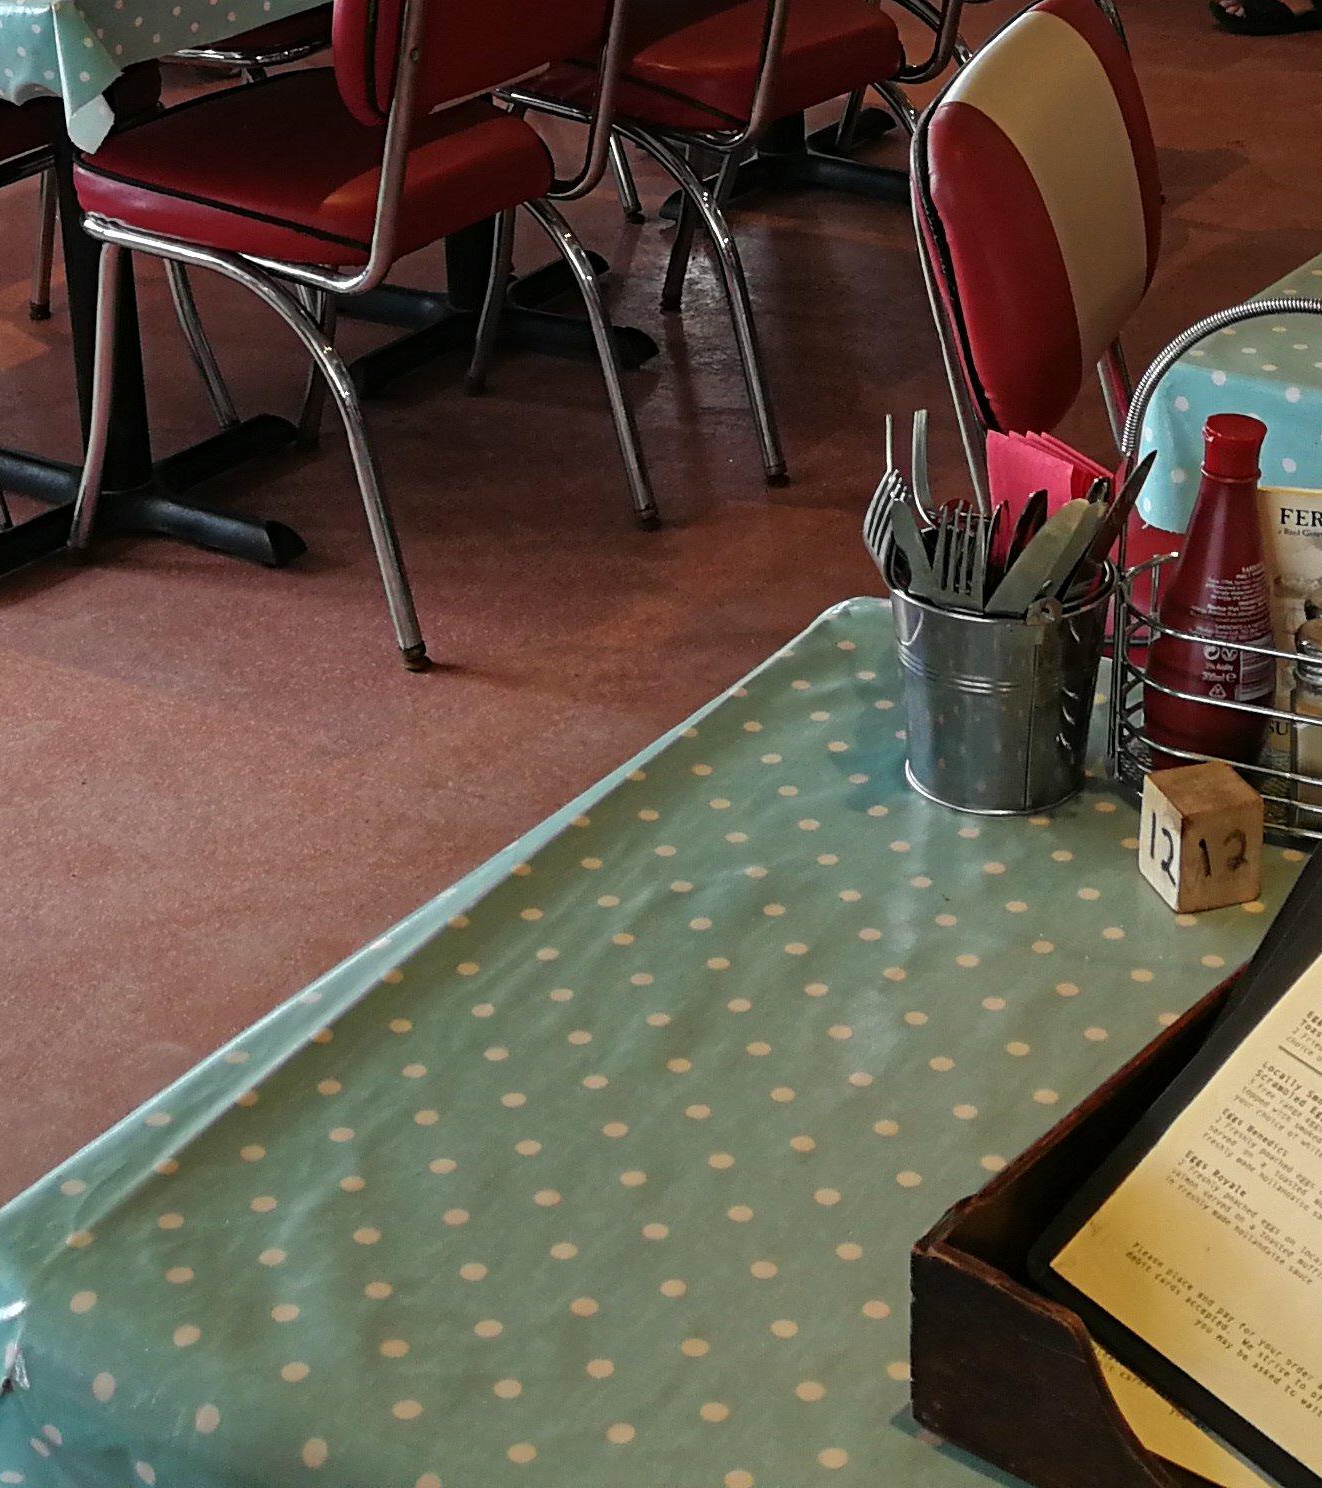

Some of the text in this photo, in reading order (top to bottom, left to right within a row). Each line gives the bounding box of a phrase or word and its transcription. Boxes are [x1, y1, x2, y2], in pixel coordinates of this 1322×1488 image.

[1150, 811, 1177, 886] 12
[1198, 828, 1248, 878] 12
[1254, 1069, 1307, 1107] Scrambled
[1261, 1061, 1303, 1093] Locally
[1184, 1149, 1208, 1170] Eggs
[1211, 1168, 1246, 1197] Royale
